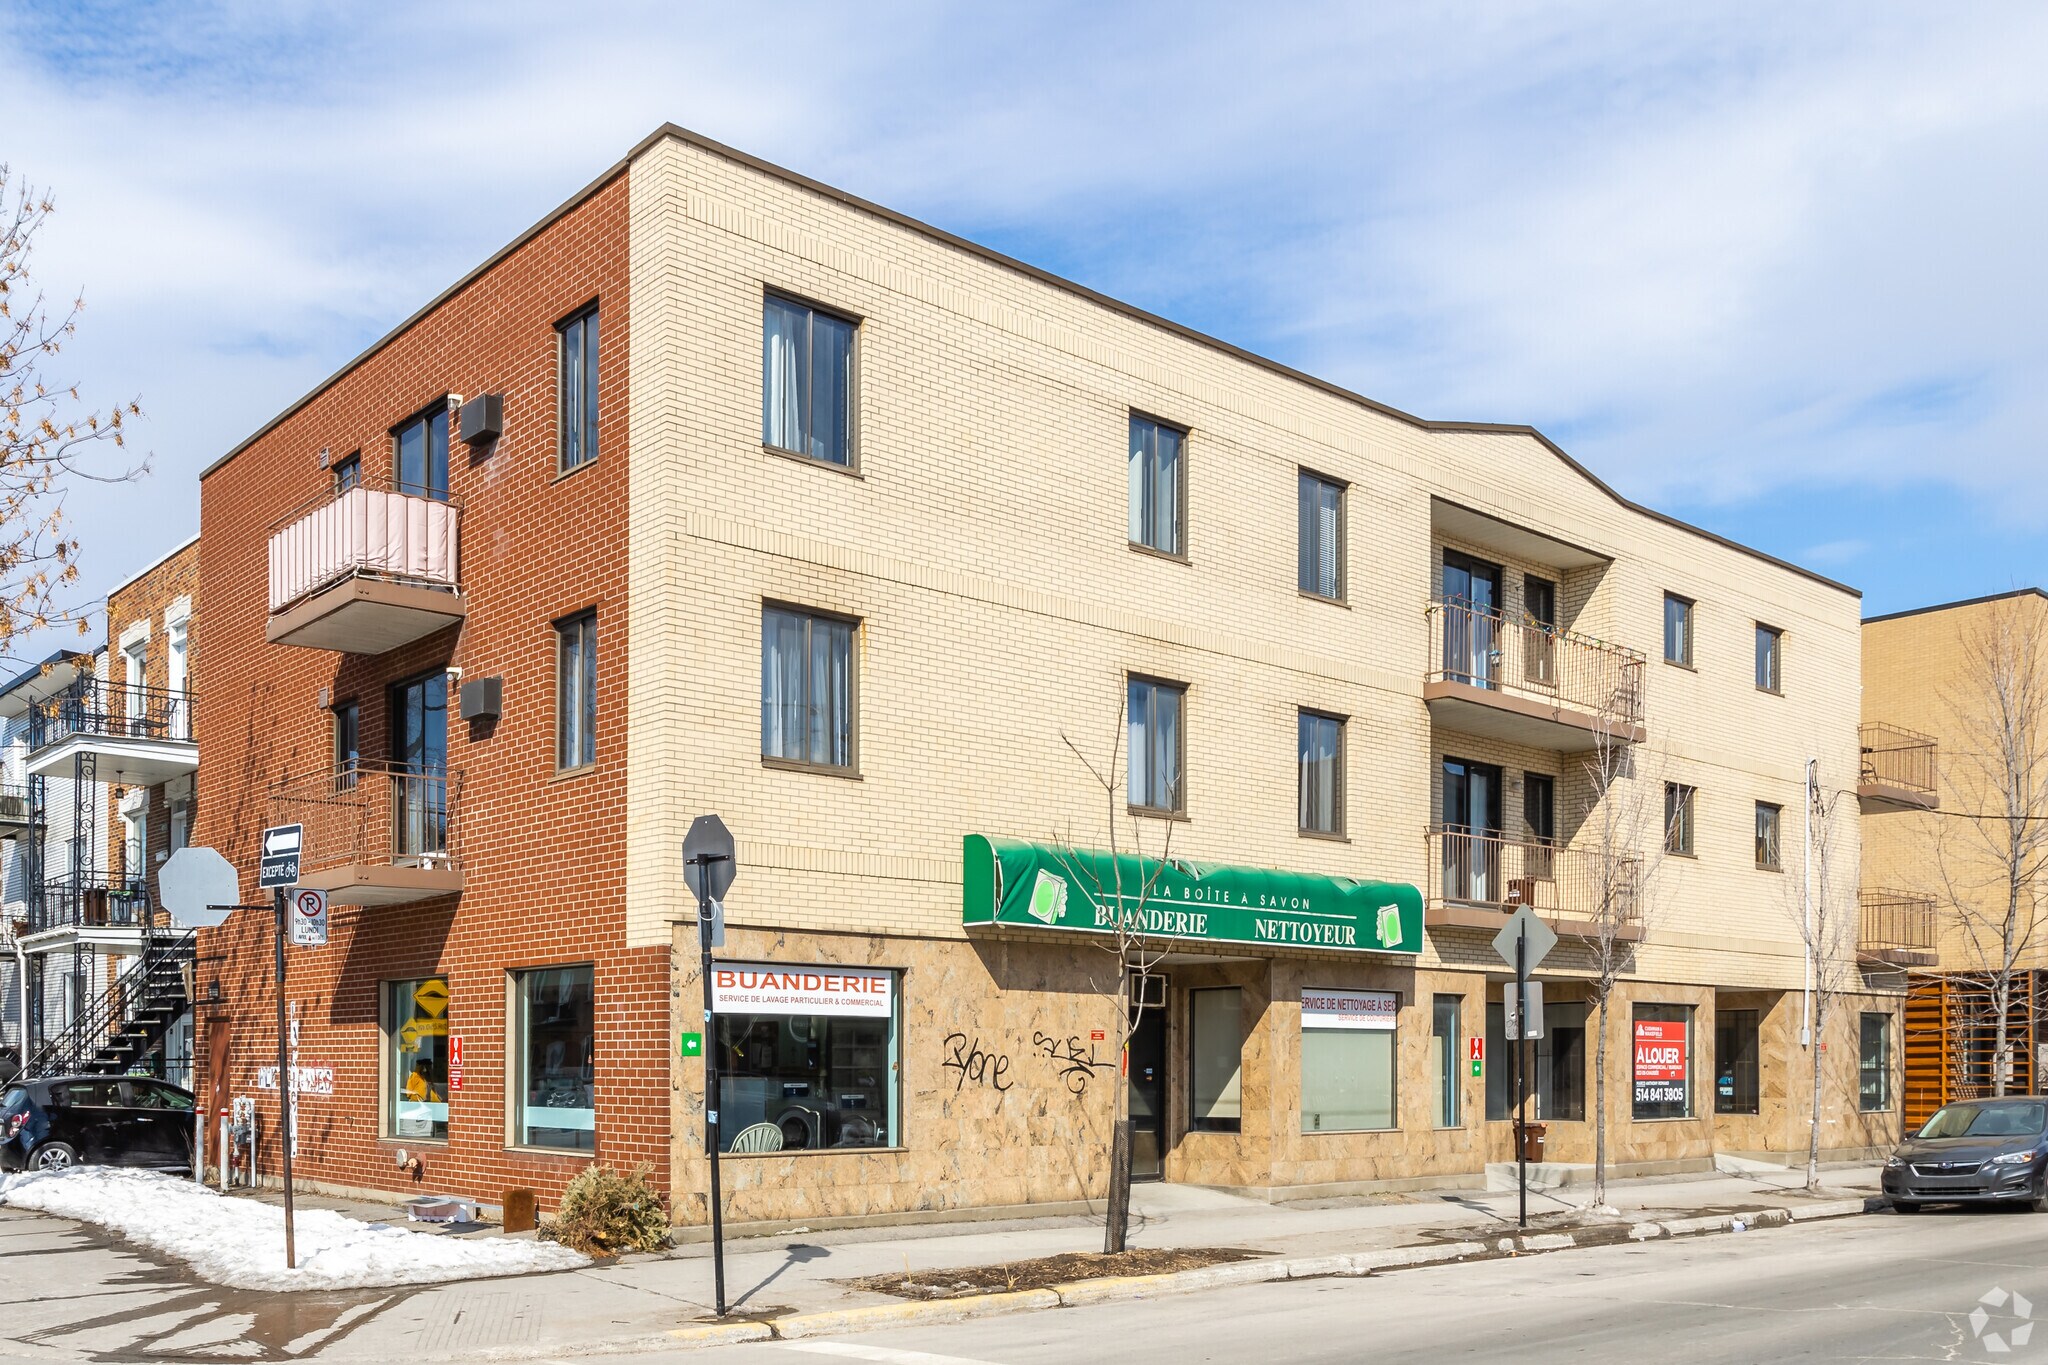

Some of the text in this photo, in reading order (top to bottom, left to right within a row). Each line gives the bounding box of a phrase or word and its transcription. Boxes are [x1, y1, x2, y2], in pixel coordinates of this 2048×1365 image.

[262, 863, 285, 879] EXCEPTÉ
[1153, 884, 1310, 910] LA BOÎTE À SAVON
[301, 926, 319, 934] LUNDI
[1254, 918, 1356, 945] NETTOYEUR
[716, 970, 886, 993] BUANDERIE
[719, 994, 749, 1003] SERVICE
[750, 995, 761, 1003] DE
[762, 996, 789, 1004] LAVAGE
[790, 997, 834, 1005] PARTICULIER
[841, 998, 884, 1007] COMMERCIAL
[1301, 997, 1396, 1012] ERVICE DE NETTOYAGE À SEC
[1636, 1044, 1679, 1064] À LOUER
[1635, 1087, 1684, 1102] 514 841 3805
